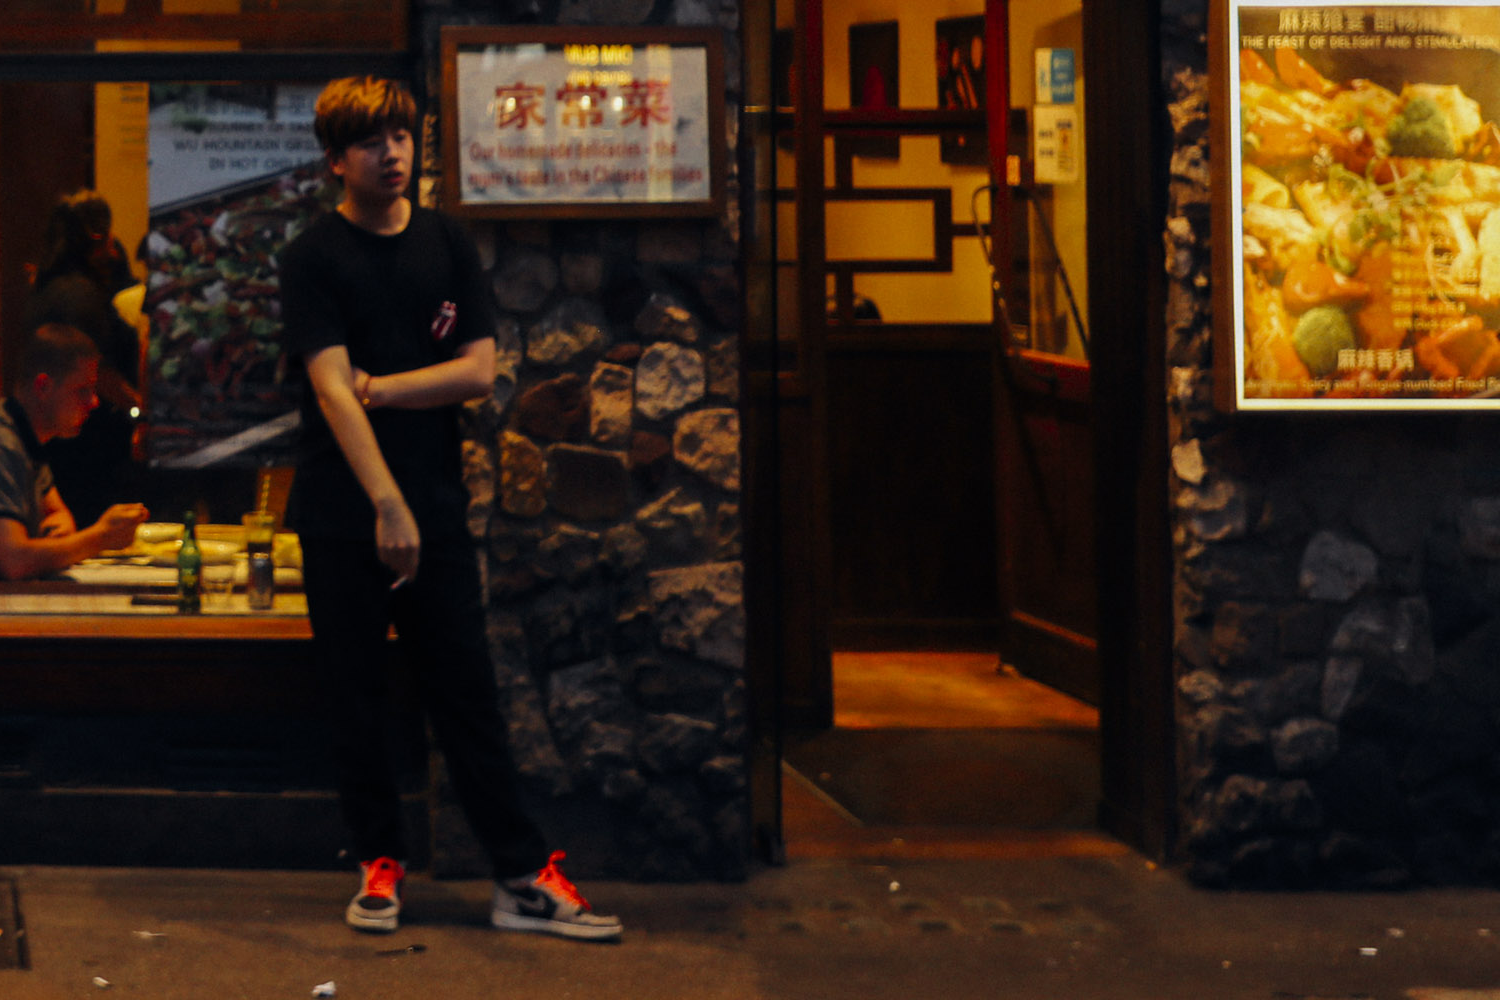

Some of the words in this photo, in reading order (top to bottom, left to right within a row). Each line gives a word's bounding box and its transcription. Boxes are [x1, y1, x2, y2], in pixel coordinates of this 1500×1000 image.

[1241, 35, 1265, 48] THE
[1267, 35, 1306, 48] FEAST
[1308, 35, 1326, 48] OF
[495, 80, 673, 129] 家常菜
